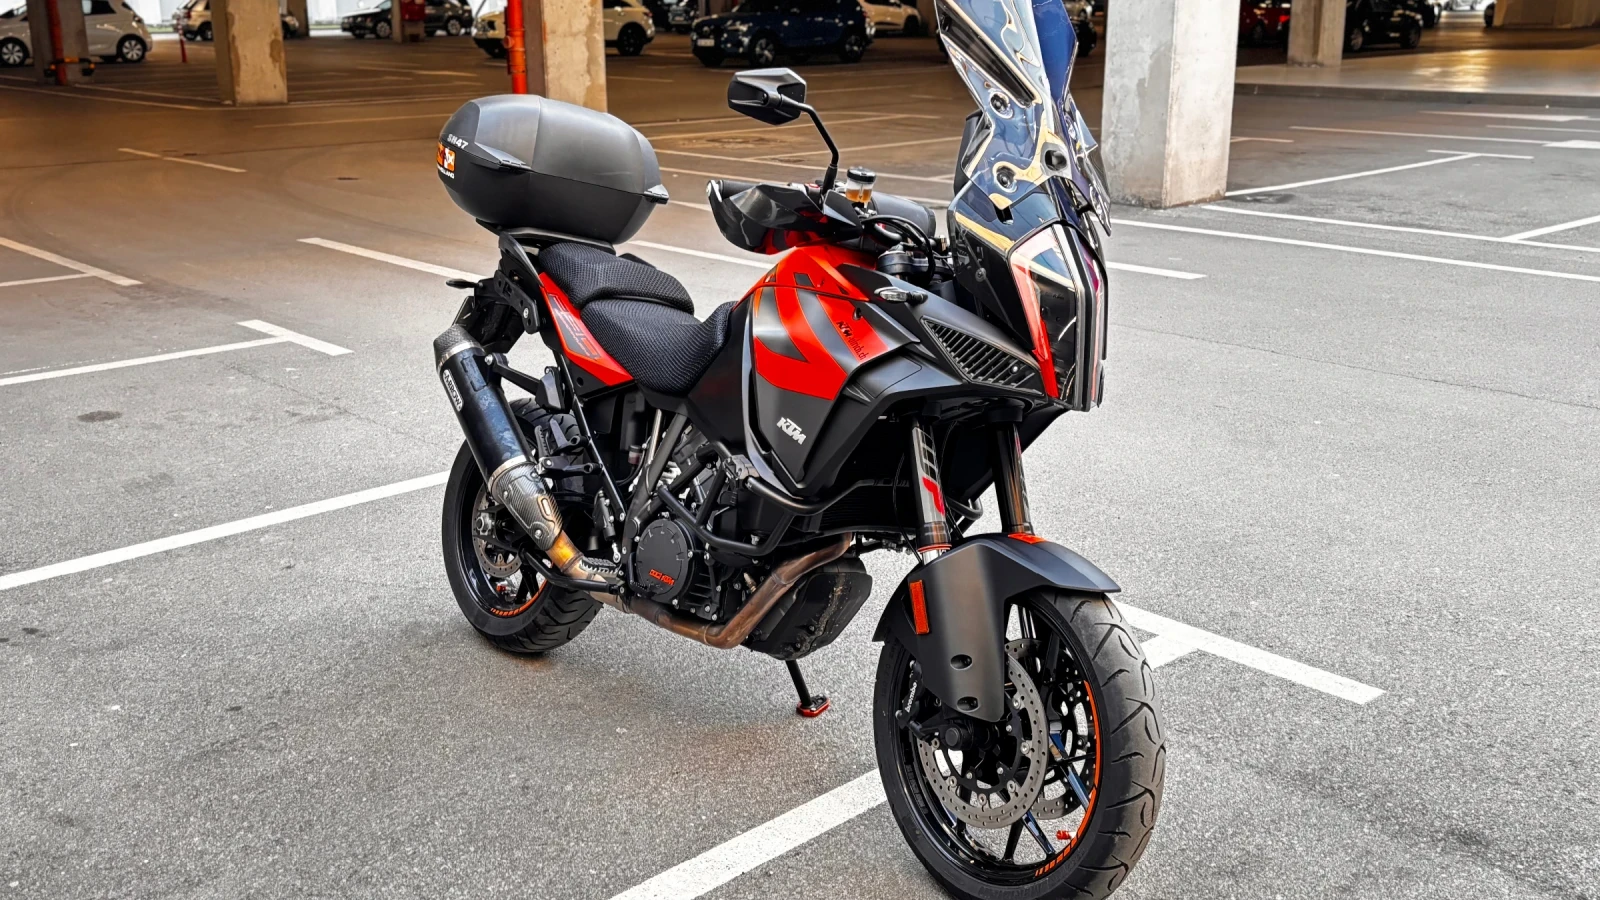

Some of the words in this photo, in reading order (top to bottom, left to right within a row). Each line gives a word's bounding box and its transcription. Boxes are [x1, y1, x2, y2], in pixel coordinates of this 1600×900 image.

[447, 133, 469, 149] SH47
[444, 372, 462, 407] ARROW
[776, 416, 807, 445] KTM
[904, 681, 918, 713] brembo
